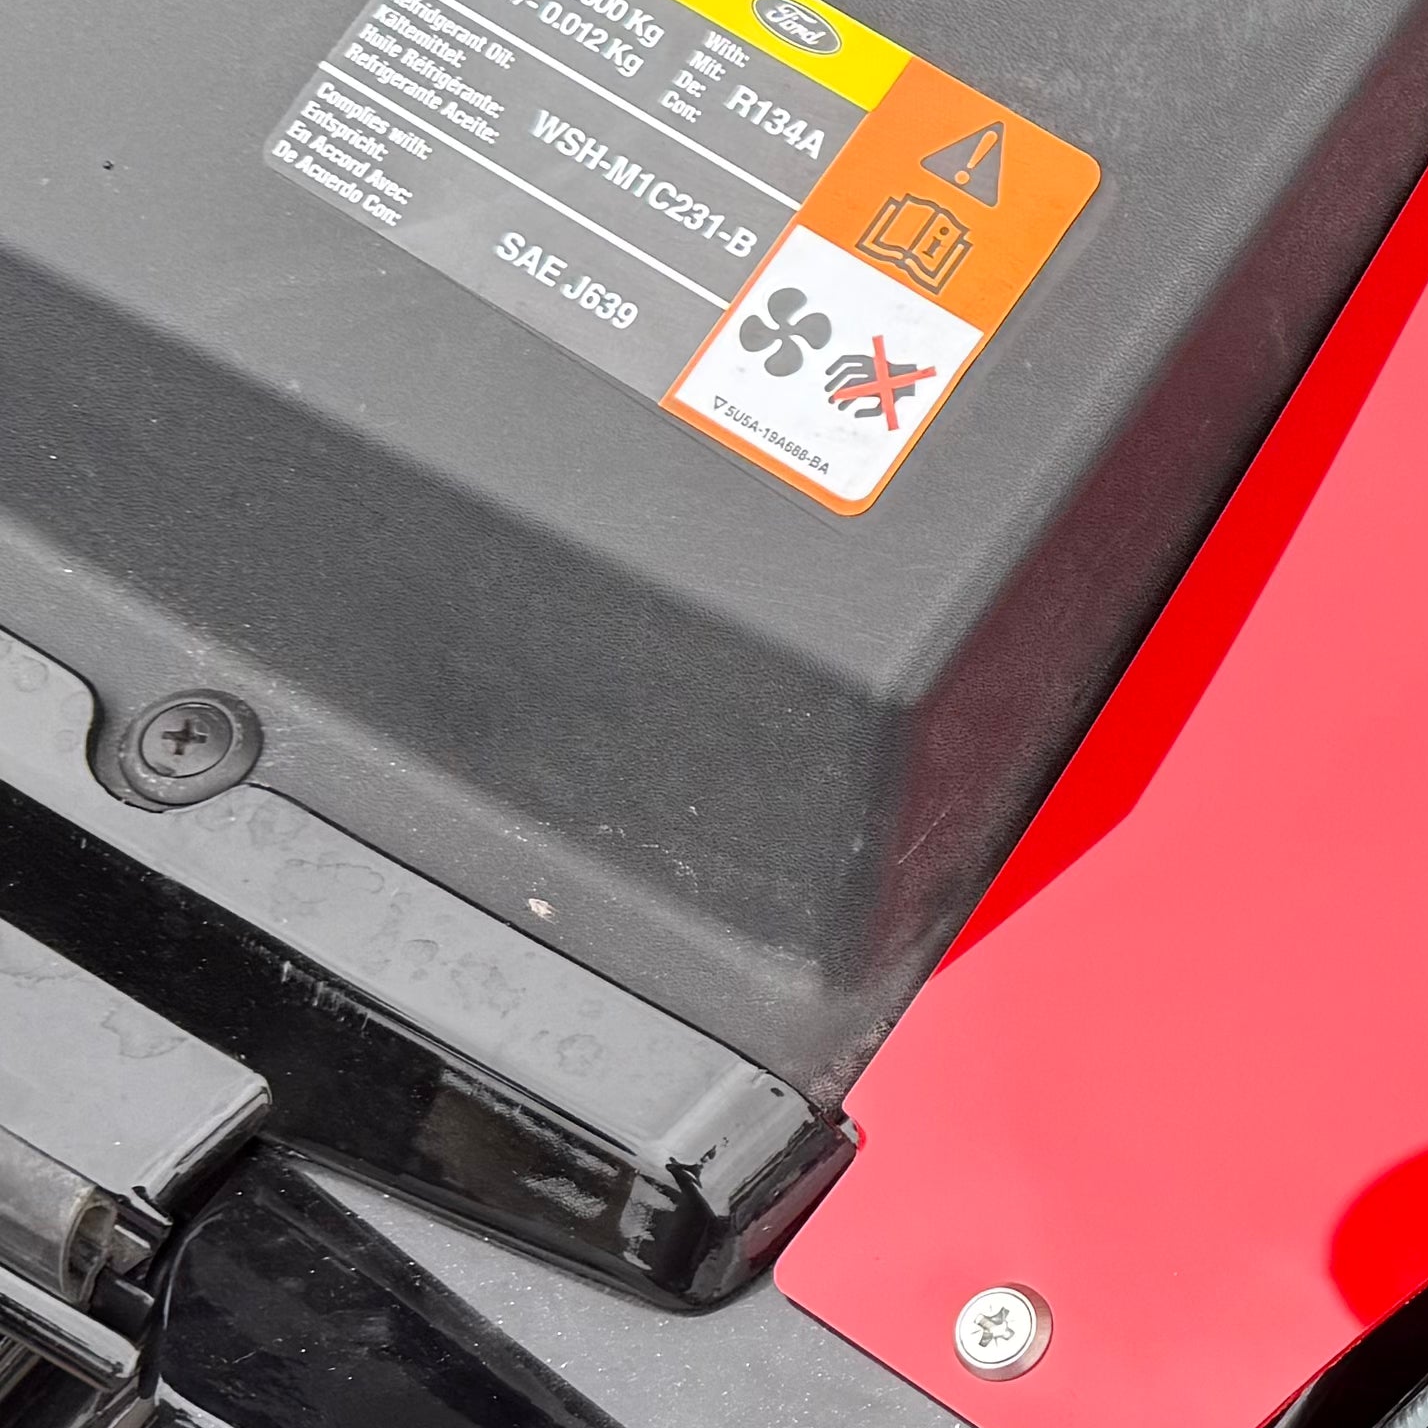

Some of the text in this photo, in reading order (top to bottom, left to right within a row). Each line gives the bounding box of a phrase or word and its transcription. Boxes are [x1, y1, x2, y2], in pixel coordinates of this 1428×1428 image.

[358, 23, 403, 58] Huile
[538, 1, 609, 53] 0.012
[602, 38, 645, 78] Kg
[623, 8, 665, 48] Kg
[704, 31, 750, 68] With:
[765, 3, 827, 45] Ford
[484, 42, 516, 70] Oil:
[672, 70, 707, 98] De:
[687, 50, 726, 82] Mit:
[316, 82, 433, 161] Complies with:
[345, 42, 500, 145] Refrigerante Aceite:
[660, 89, 702, 123] Con:
[724, 85, 826, 160] R134A
[286, 119, 414, 205] En Accord Avec:
[301, 100, 389, 162] Entspricht:
[271, 139, 402, 227] De Acuerdo Con:
[530, 108, 759, 259] WSH-M1C231-B
[495, 231, 639, 331] SAE J639
